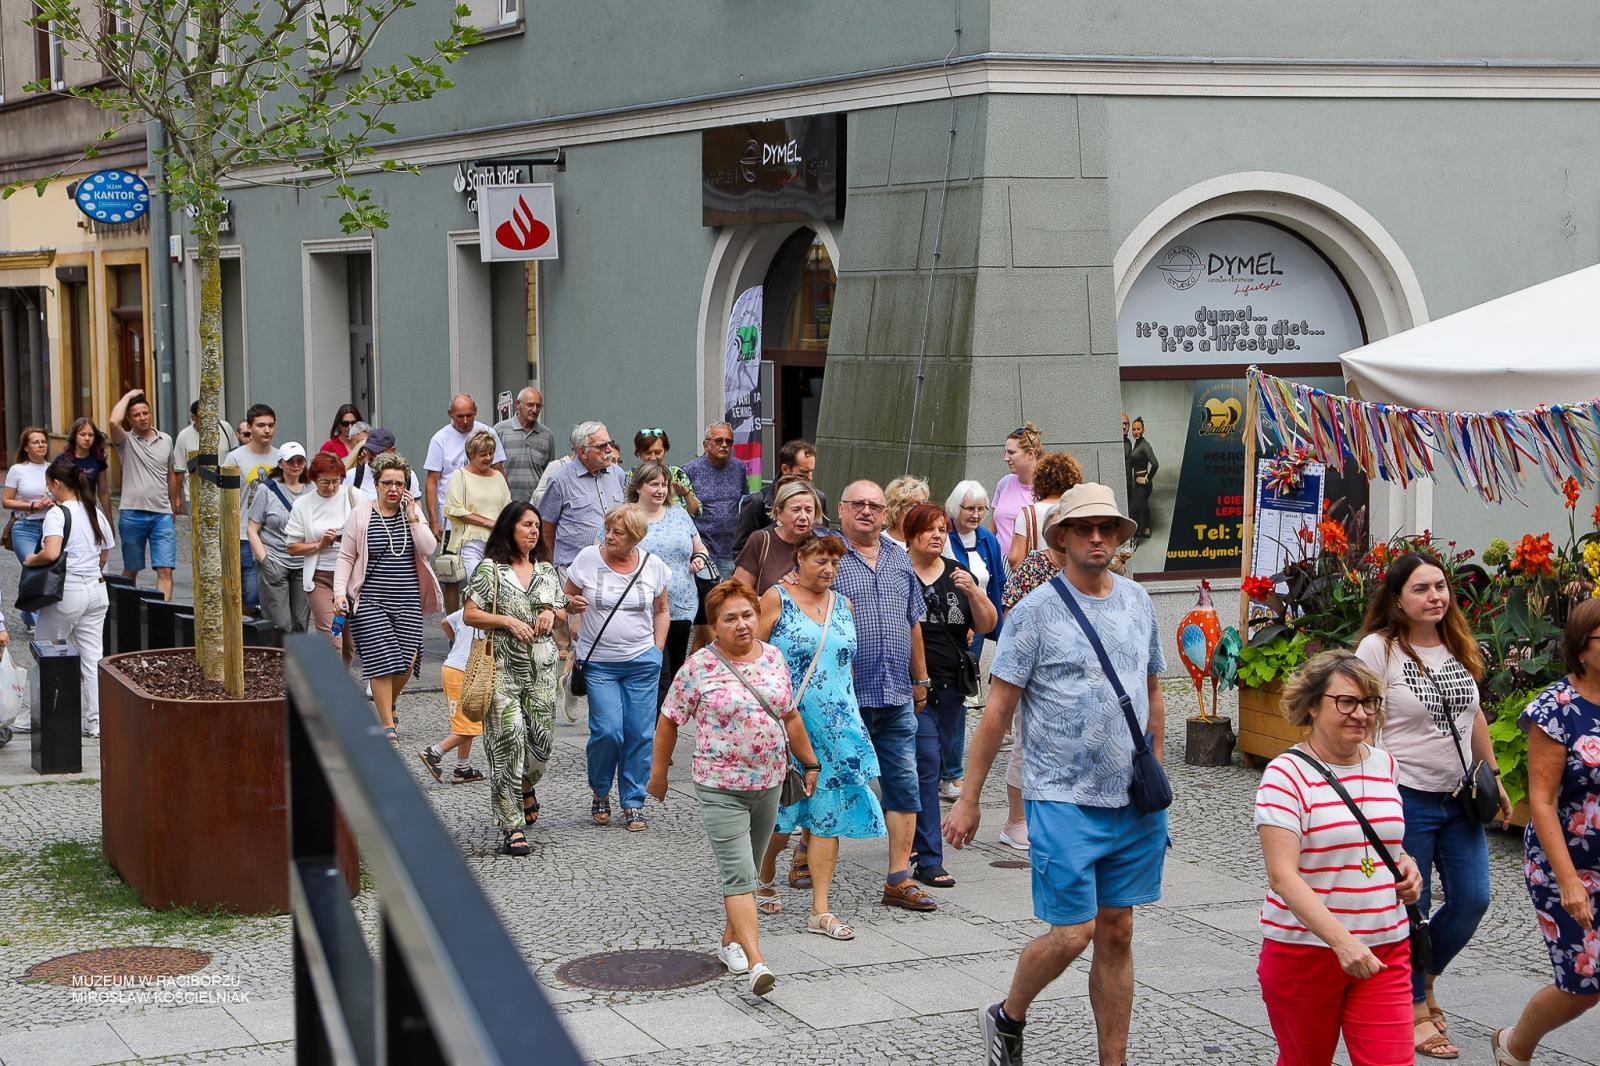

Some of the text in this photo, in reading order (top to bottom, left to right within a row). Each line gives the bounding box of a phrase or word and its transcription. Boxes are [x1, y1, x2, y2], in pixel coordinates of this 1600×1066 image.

[762, 139, 802, 165] DYMEL
[94, 191, 135, 200] KANTOR
[1207, 251, 1283, 276] DYMEL
[1194, 305, 1268, 326] dymel...
[1135, 321, 1169, 338] it's
[1173, 321, 1207, 338] not
[1208, 320, 1250, 341] just
[1255, 323, 1267, 336] a
[1161, 335, 1301, 355] it's a lifestyle.
[1223, 495, 1244, 505] CIE
[1194, 523, 1230, 540] Tel:
